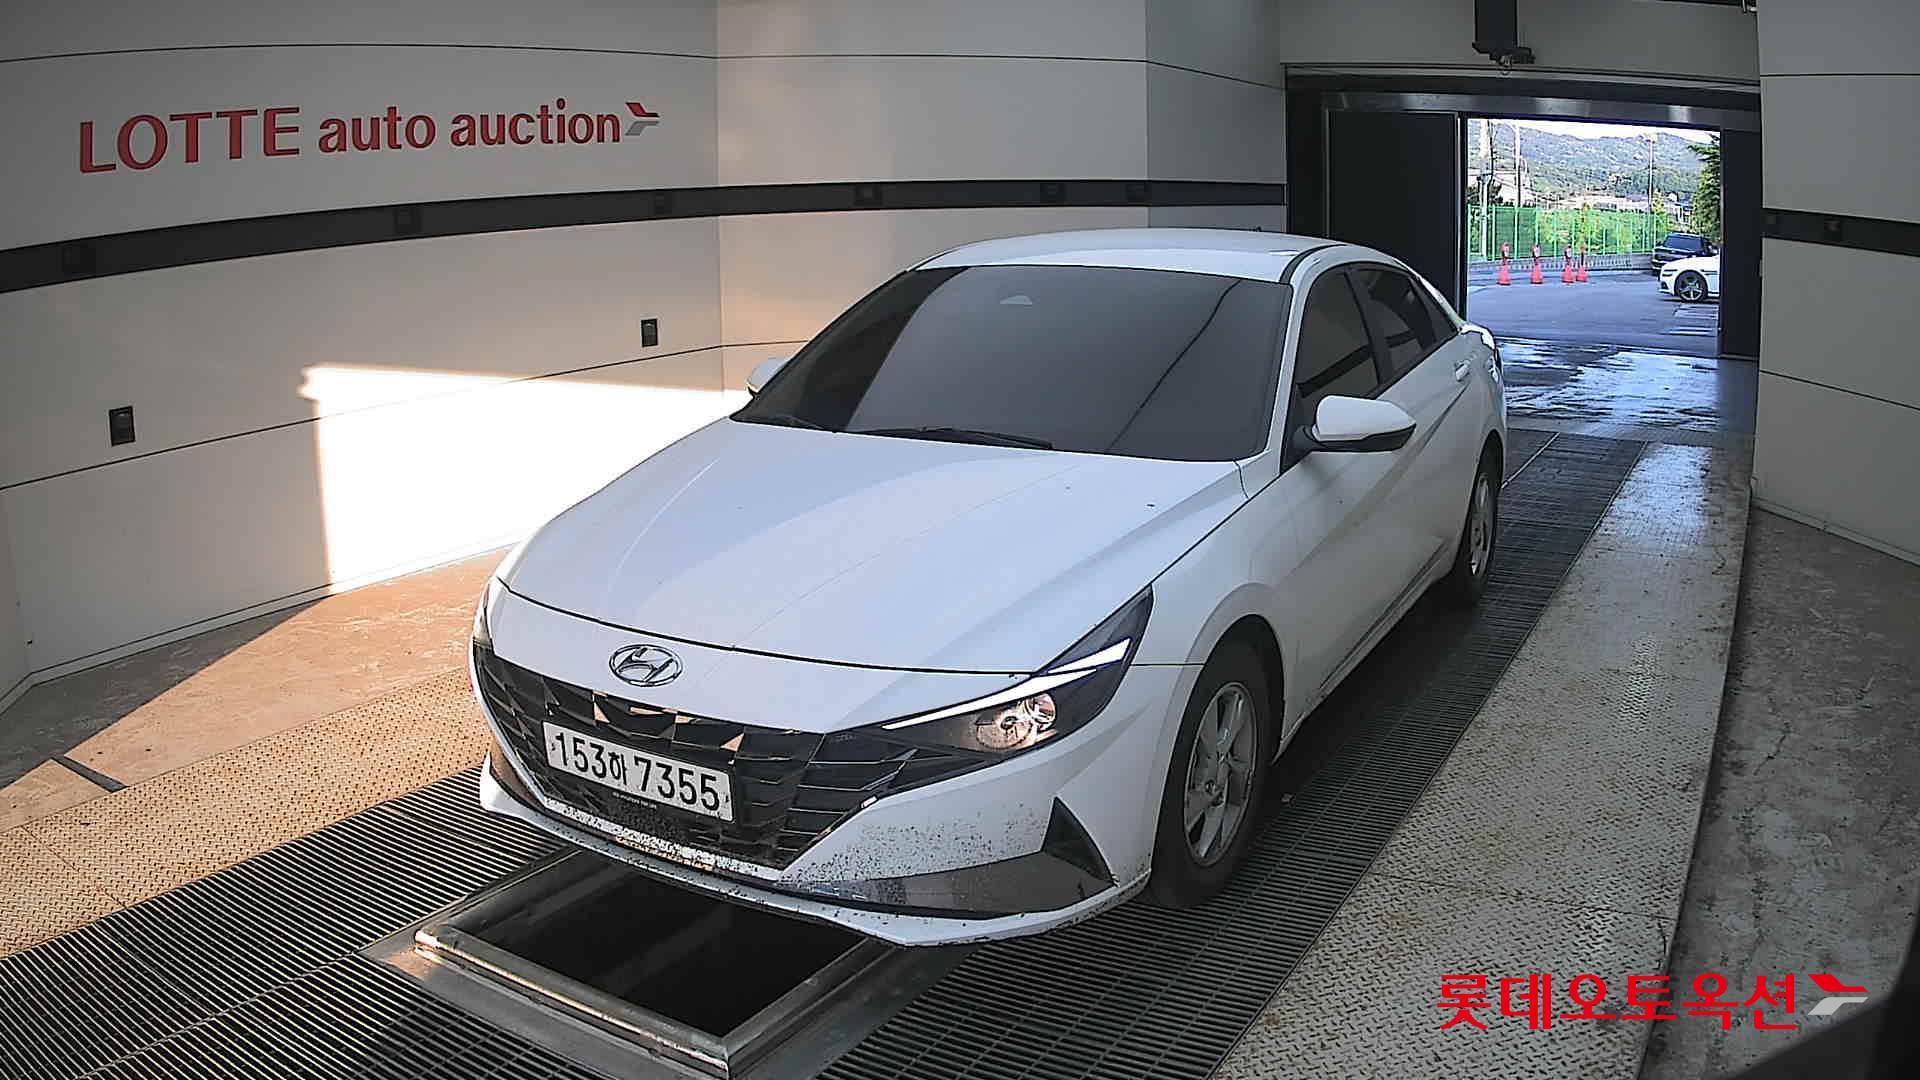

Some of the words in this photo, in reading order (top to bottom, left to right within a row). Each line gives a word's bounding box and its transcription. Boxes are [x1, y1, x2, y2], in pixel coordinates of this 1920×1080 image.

[79, 105, 302, 174] LOTTE
[318, 105, 437, 154] auto
[450, 97, 622, 146] auction
